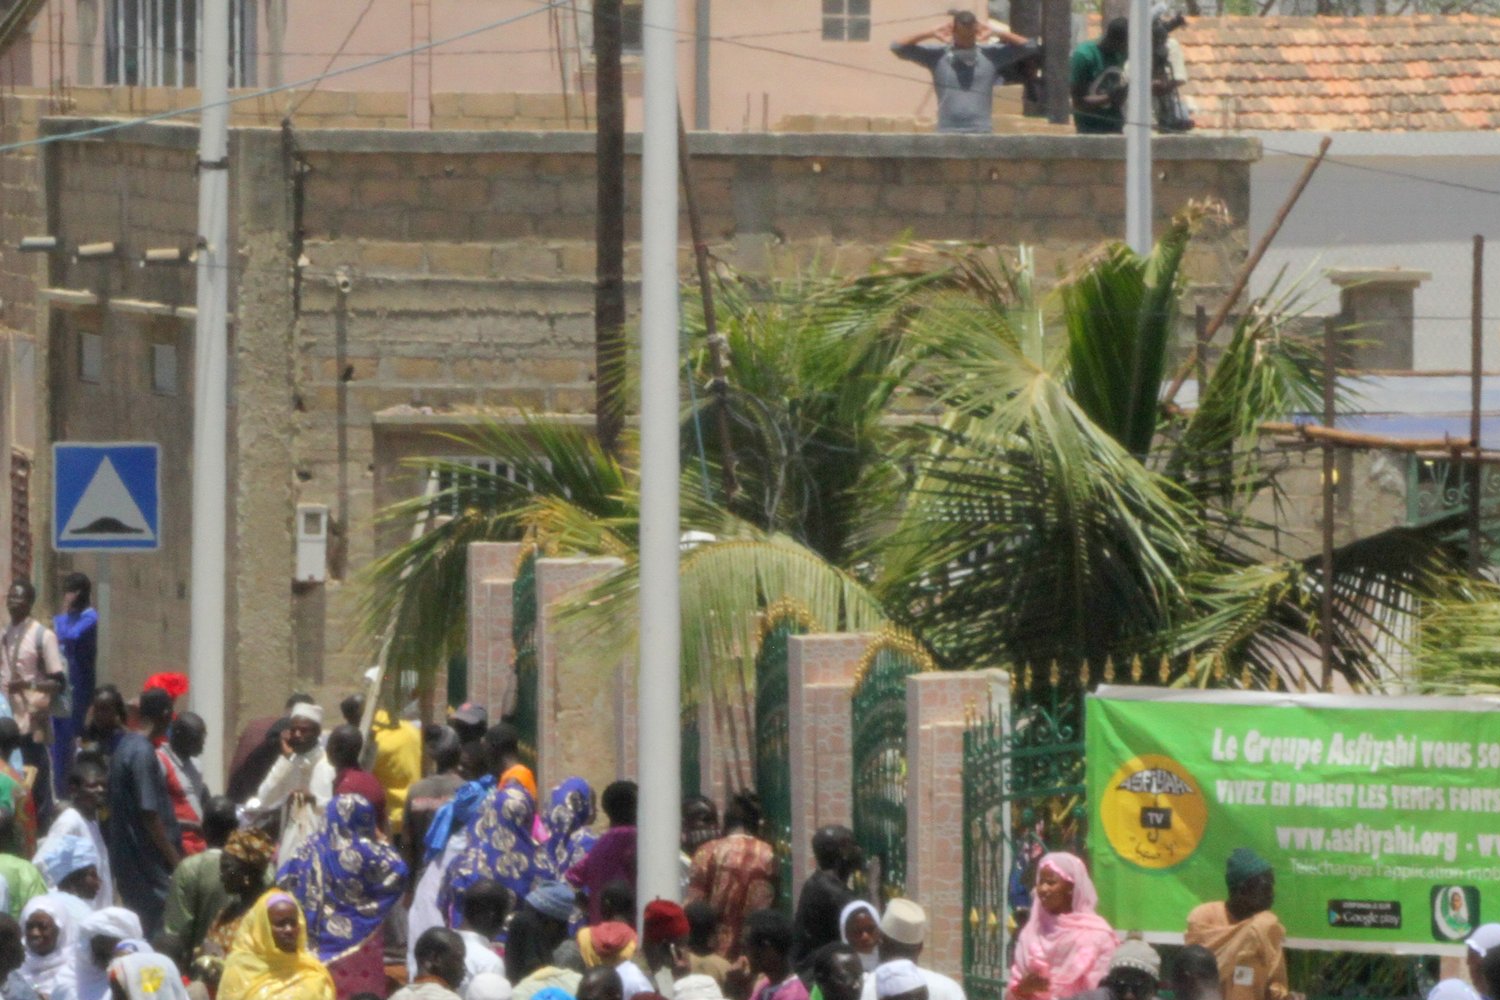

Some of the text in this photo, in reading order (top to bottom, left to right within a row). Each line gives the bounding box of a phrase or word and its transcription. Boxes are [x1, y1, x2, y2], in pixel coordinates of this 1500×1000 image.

[1211, 727, 1238, 762] Le
[1243, 729, 1324, 771] Groupe
[1327, 732, 1418, 773] Asfiyahi
[1421, 740, 1473, 769] vous
[1215, 779, 1267, 805] VIVEZ
[1270, 781, 1291, 806] EN
[1295, 783, 1355, 808] DIRECT
[1357, 784, 1387, 809] LES
[1391, 785, 1446, 811] TEMPS
[1147, 812, 1164, 825] TV
[1276, 823, 1458, 863] www.asfiyahi.org
[1342, 911, 1378, 927] Google
